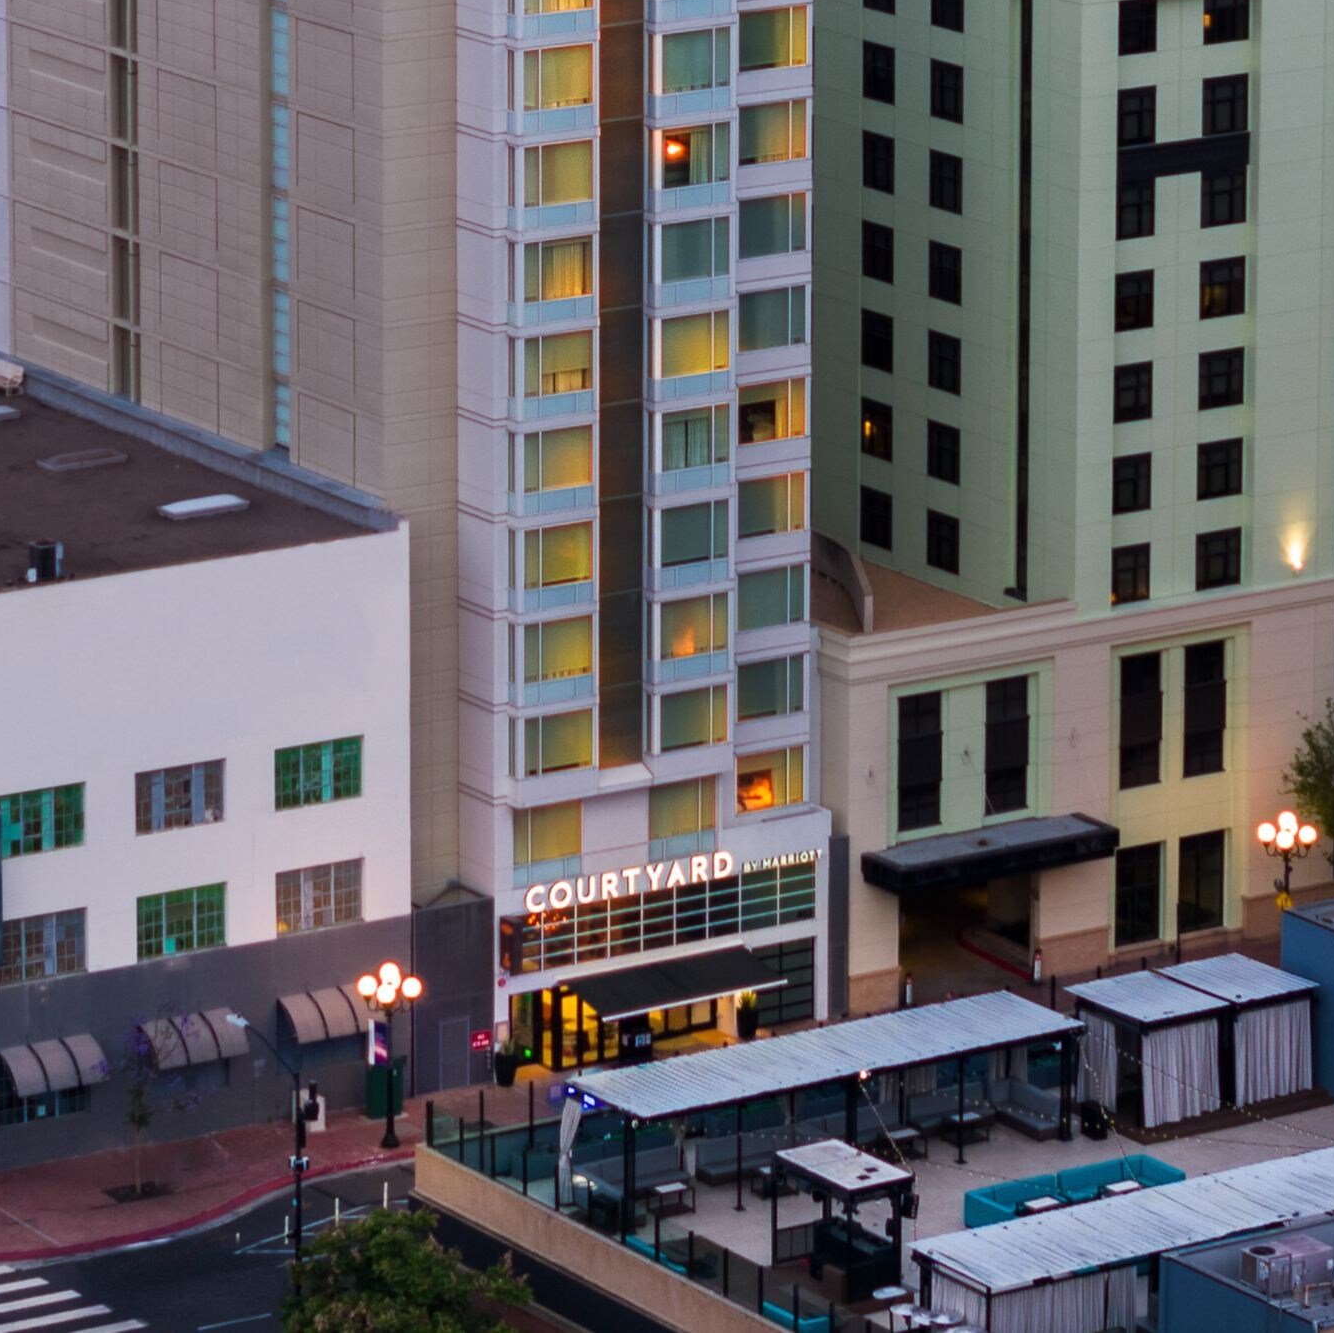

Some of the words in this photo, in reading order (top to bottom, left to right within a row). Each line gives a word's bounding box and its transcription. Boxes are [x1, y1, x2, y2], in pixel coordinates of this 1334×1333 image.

[524, 851, 735, 913] COURTYARD
[743, 860, 757, 873] BY
[761, 848, 823, 870] MARRIOTT
